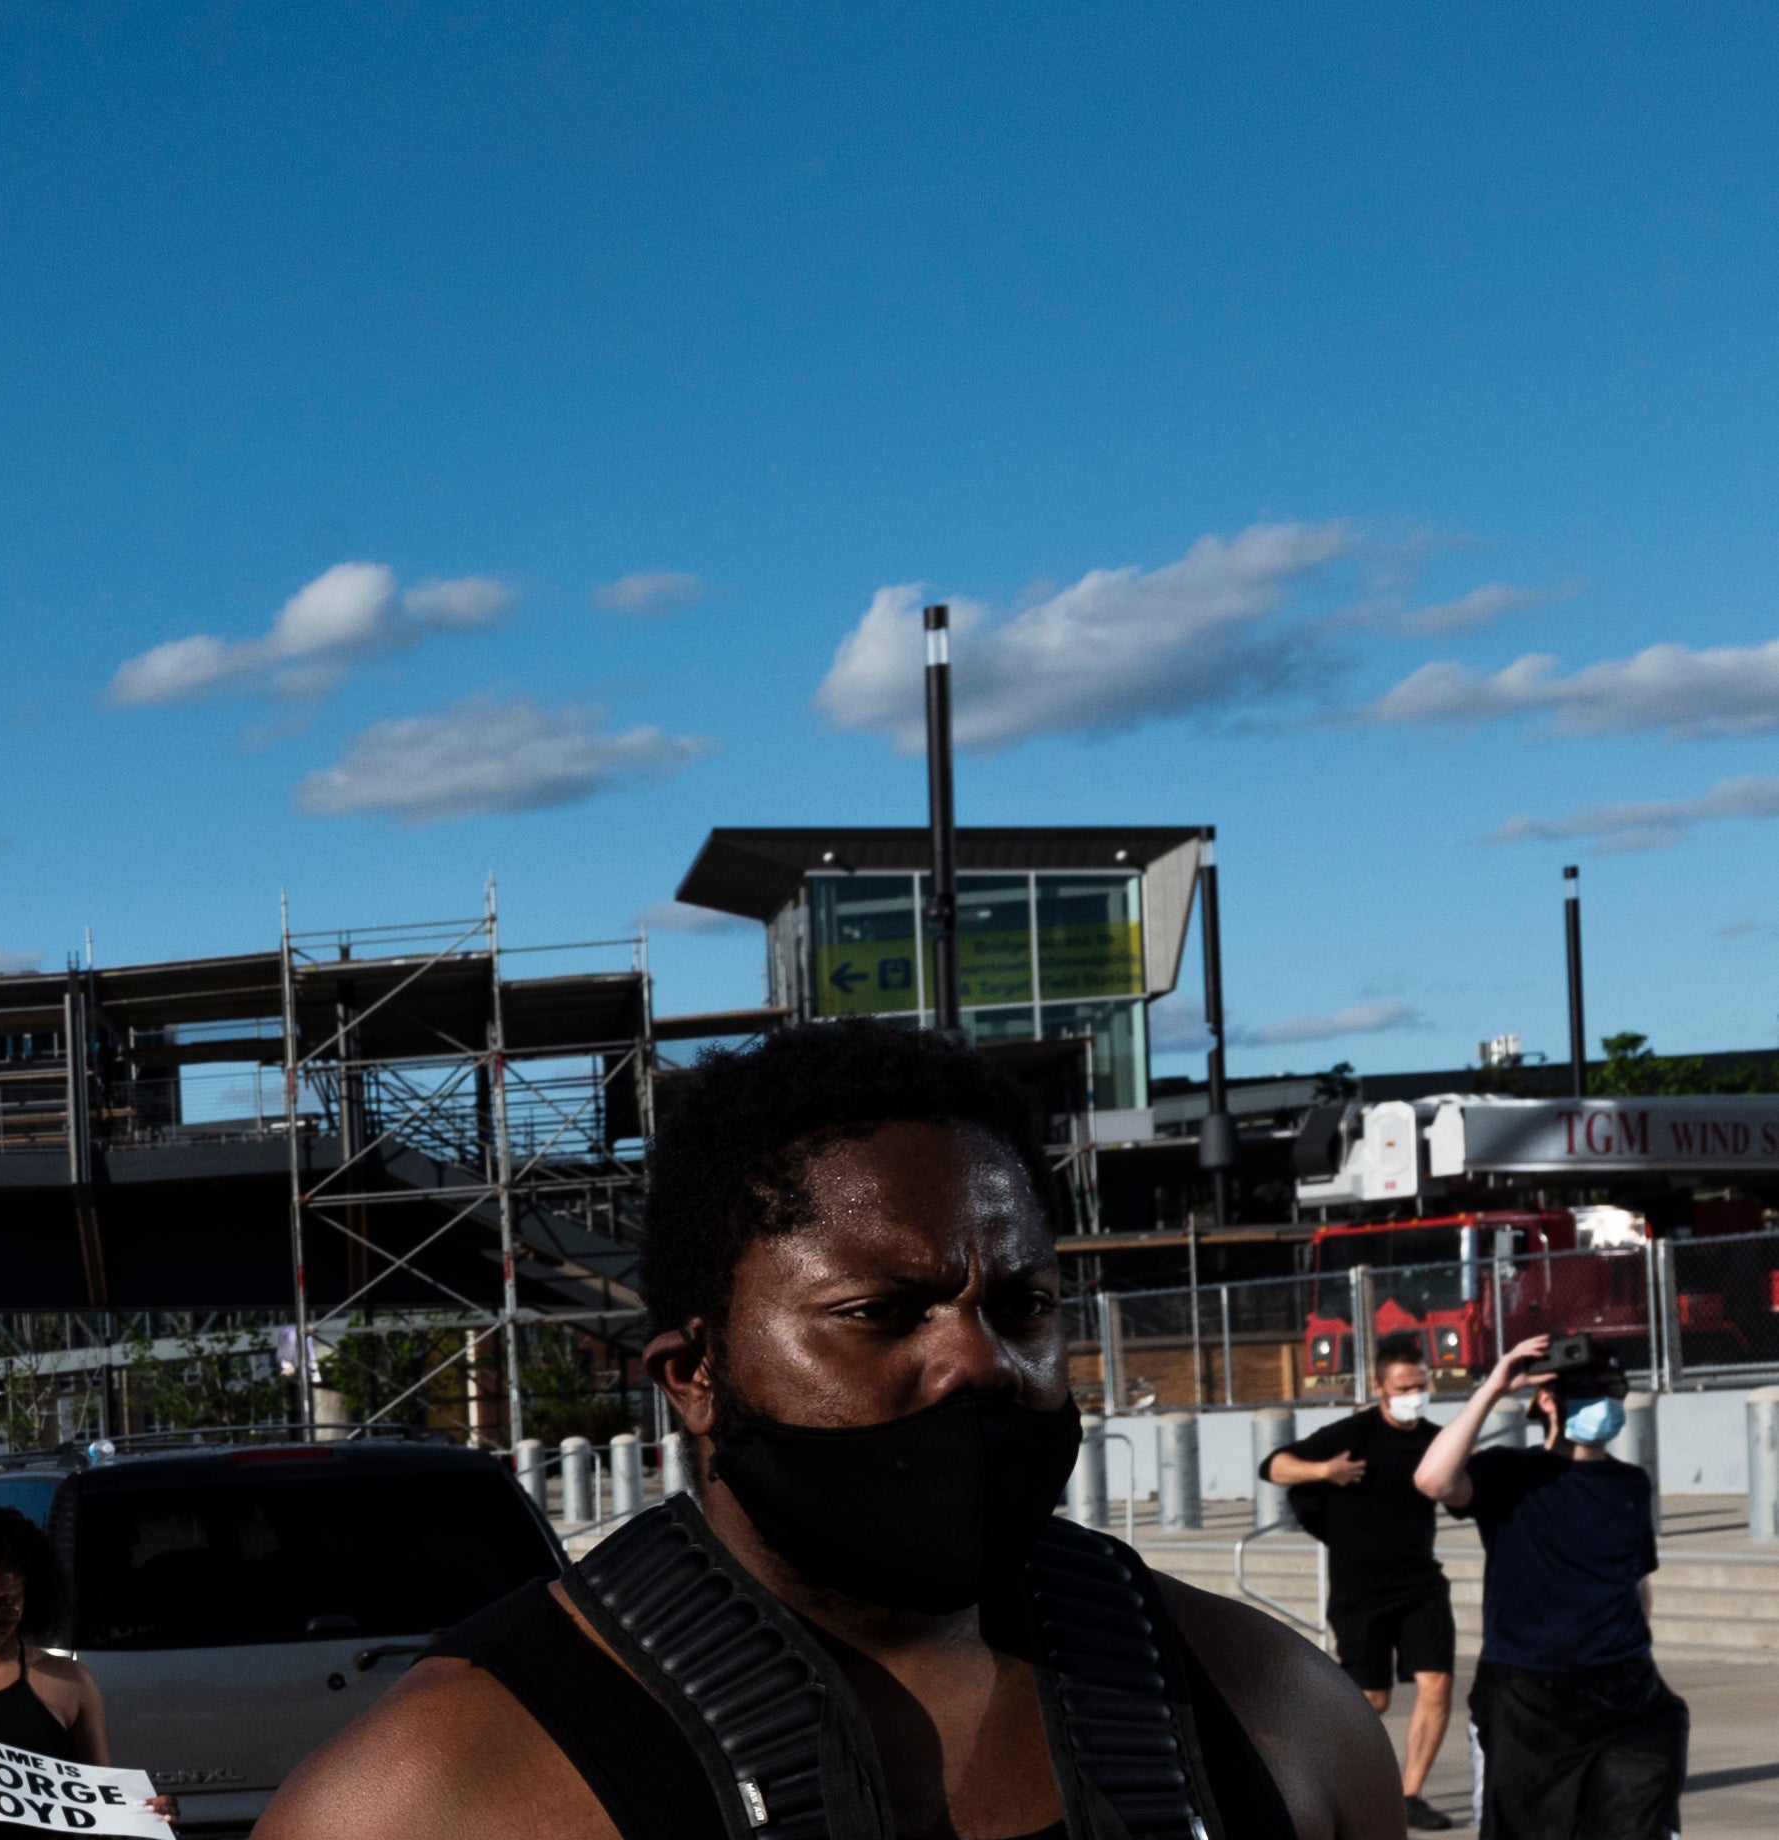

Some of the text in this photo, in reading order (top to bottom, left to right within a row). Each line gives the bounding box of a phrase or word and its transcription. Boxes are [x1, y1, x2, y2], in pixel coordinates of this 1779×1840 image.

[1557, 1110, 1650, 1156] TGM
[1670, 1121, 1750, 1155] WIND
[55, 1762, 82, 1778] IS
